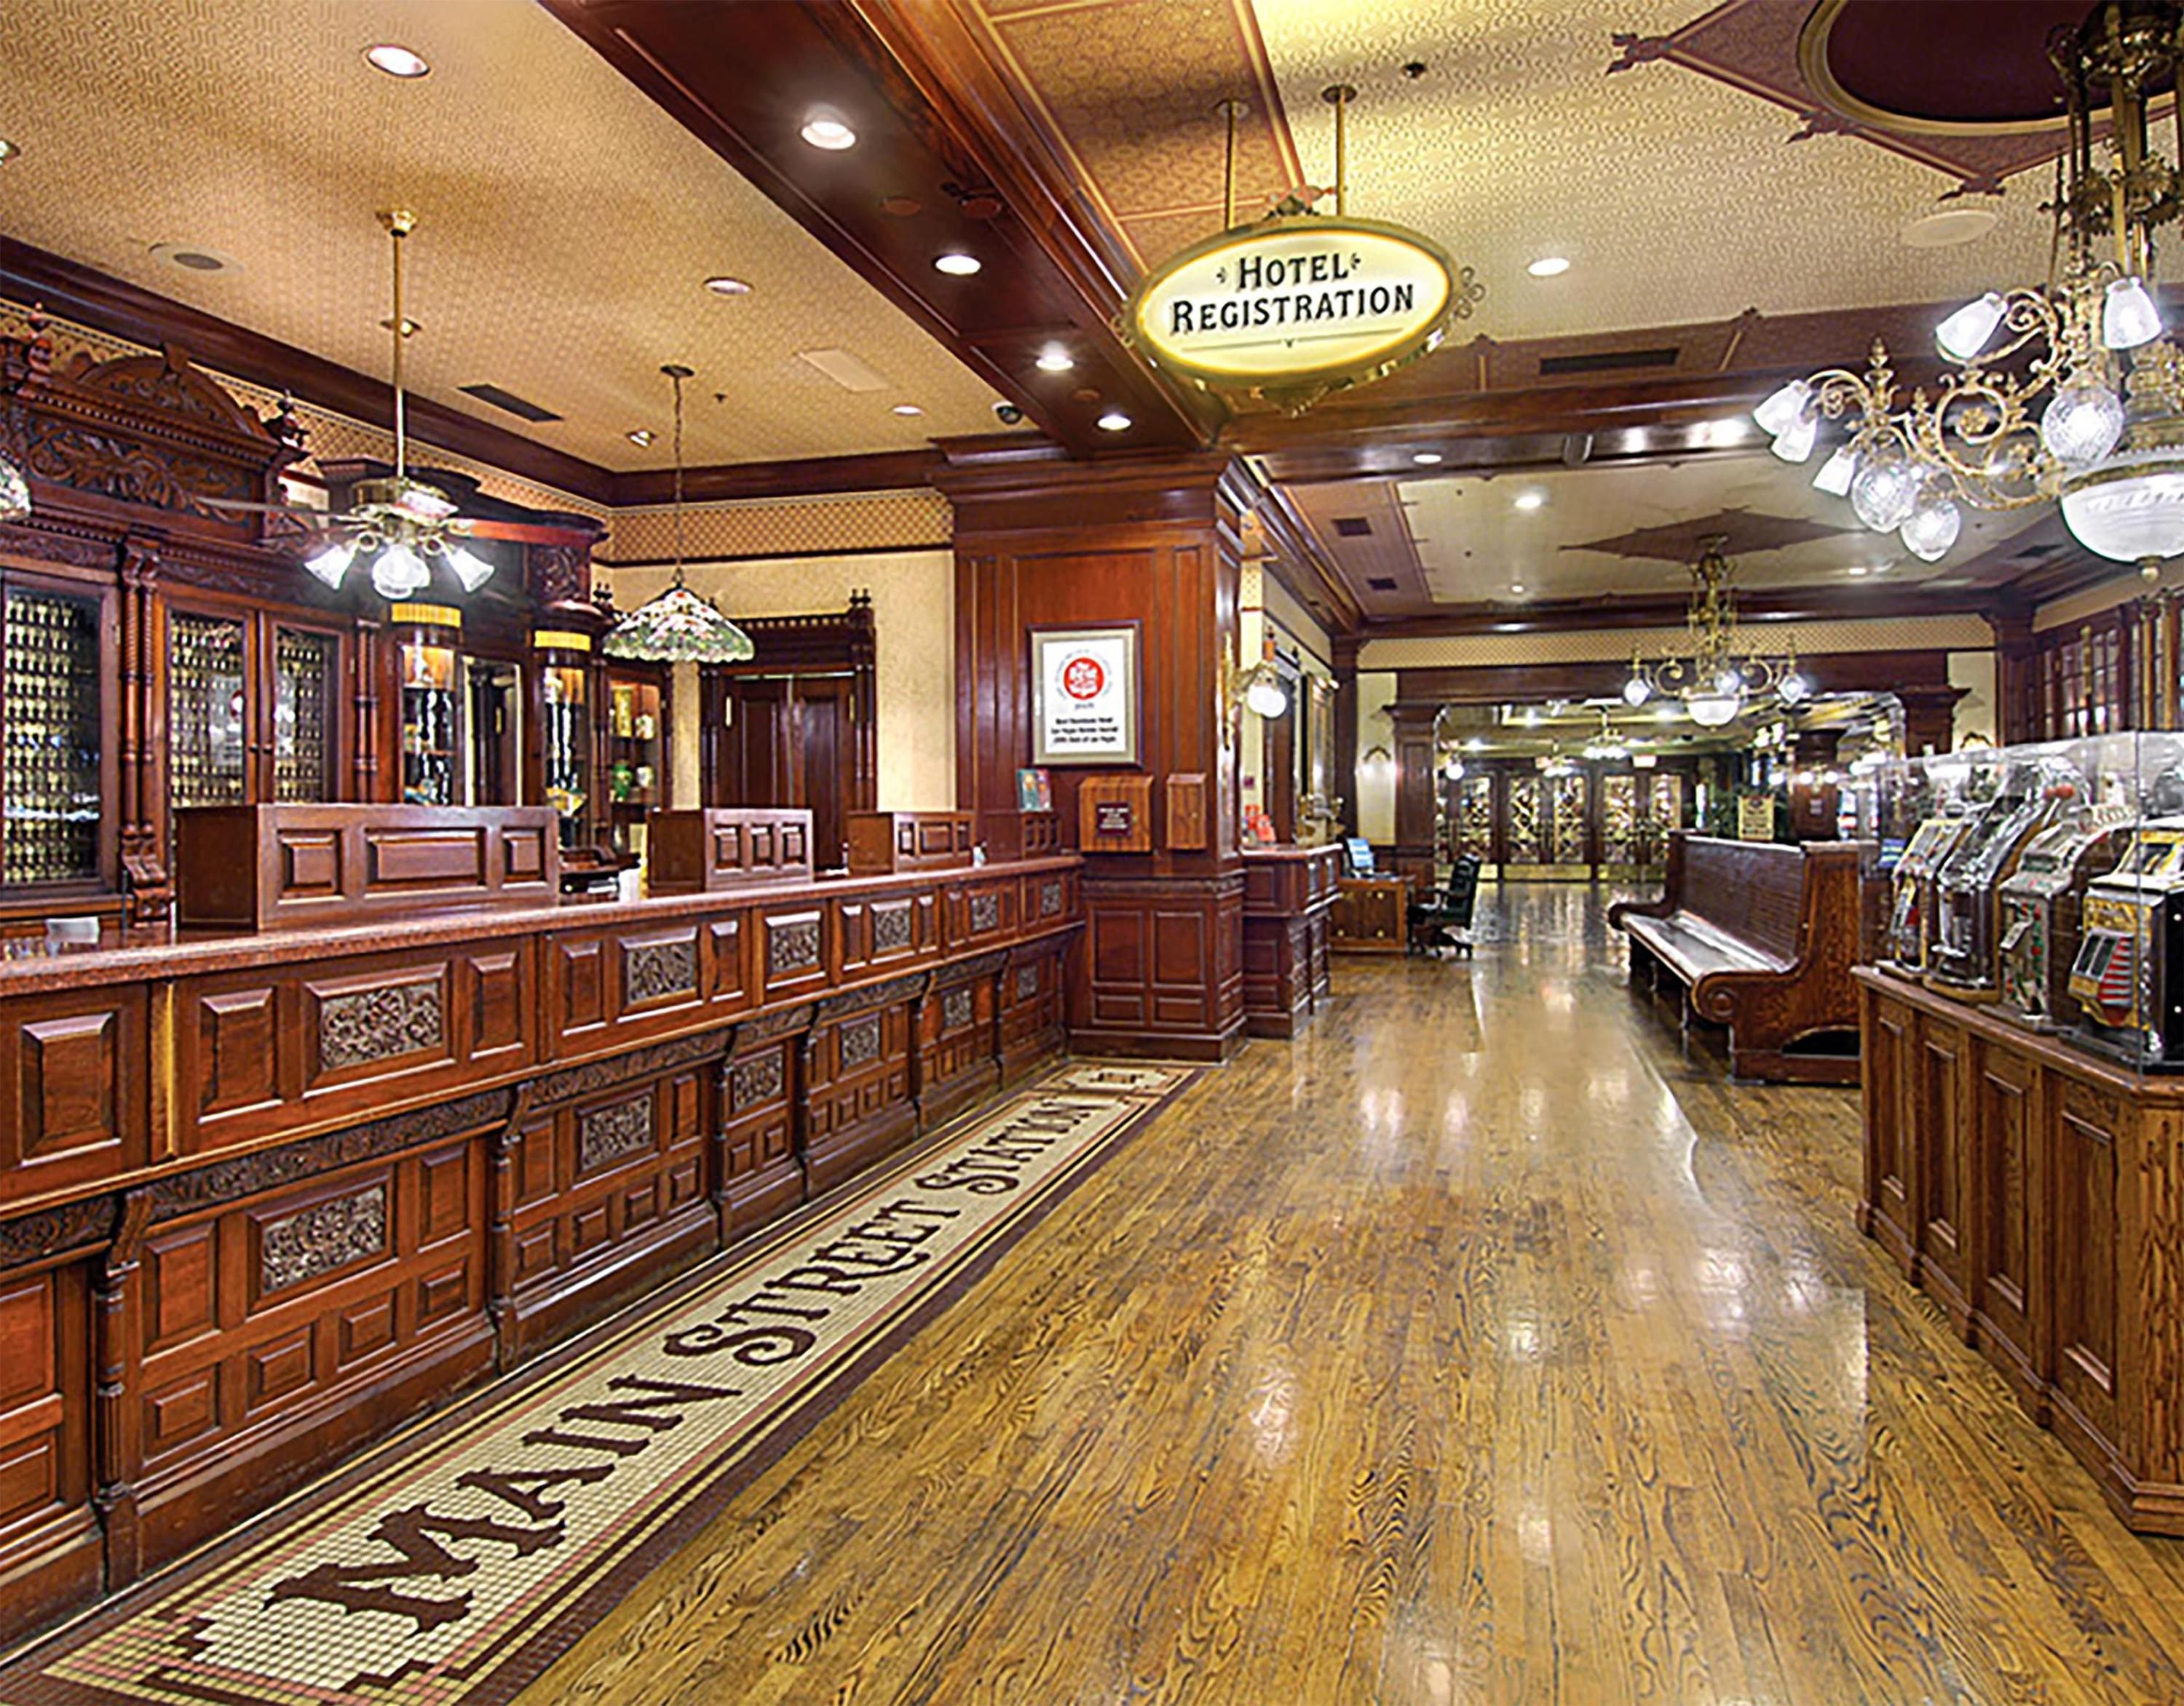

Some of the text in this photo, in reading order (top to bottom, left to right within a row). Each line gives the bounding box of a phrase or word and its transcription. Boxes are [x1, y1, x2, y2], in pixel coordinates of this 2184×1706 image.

[1238, 253, 1350, 290] HOTEL
[1171, 284, 1415, 333] REGISTRATION
[263, 1097, 1112, 1634] MAIN STREET STATION
